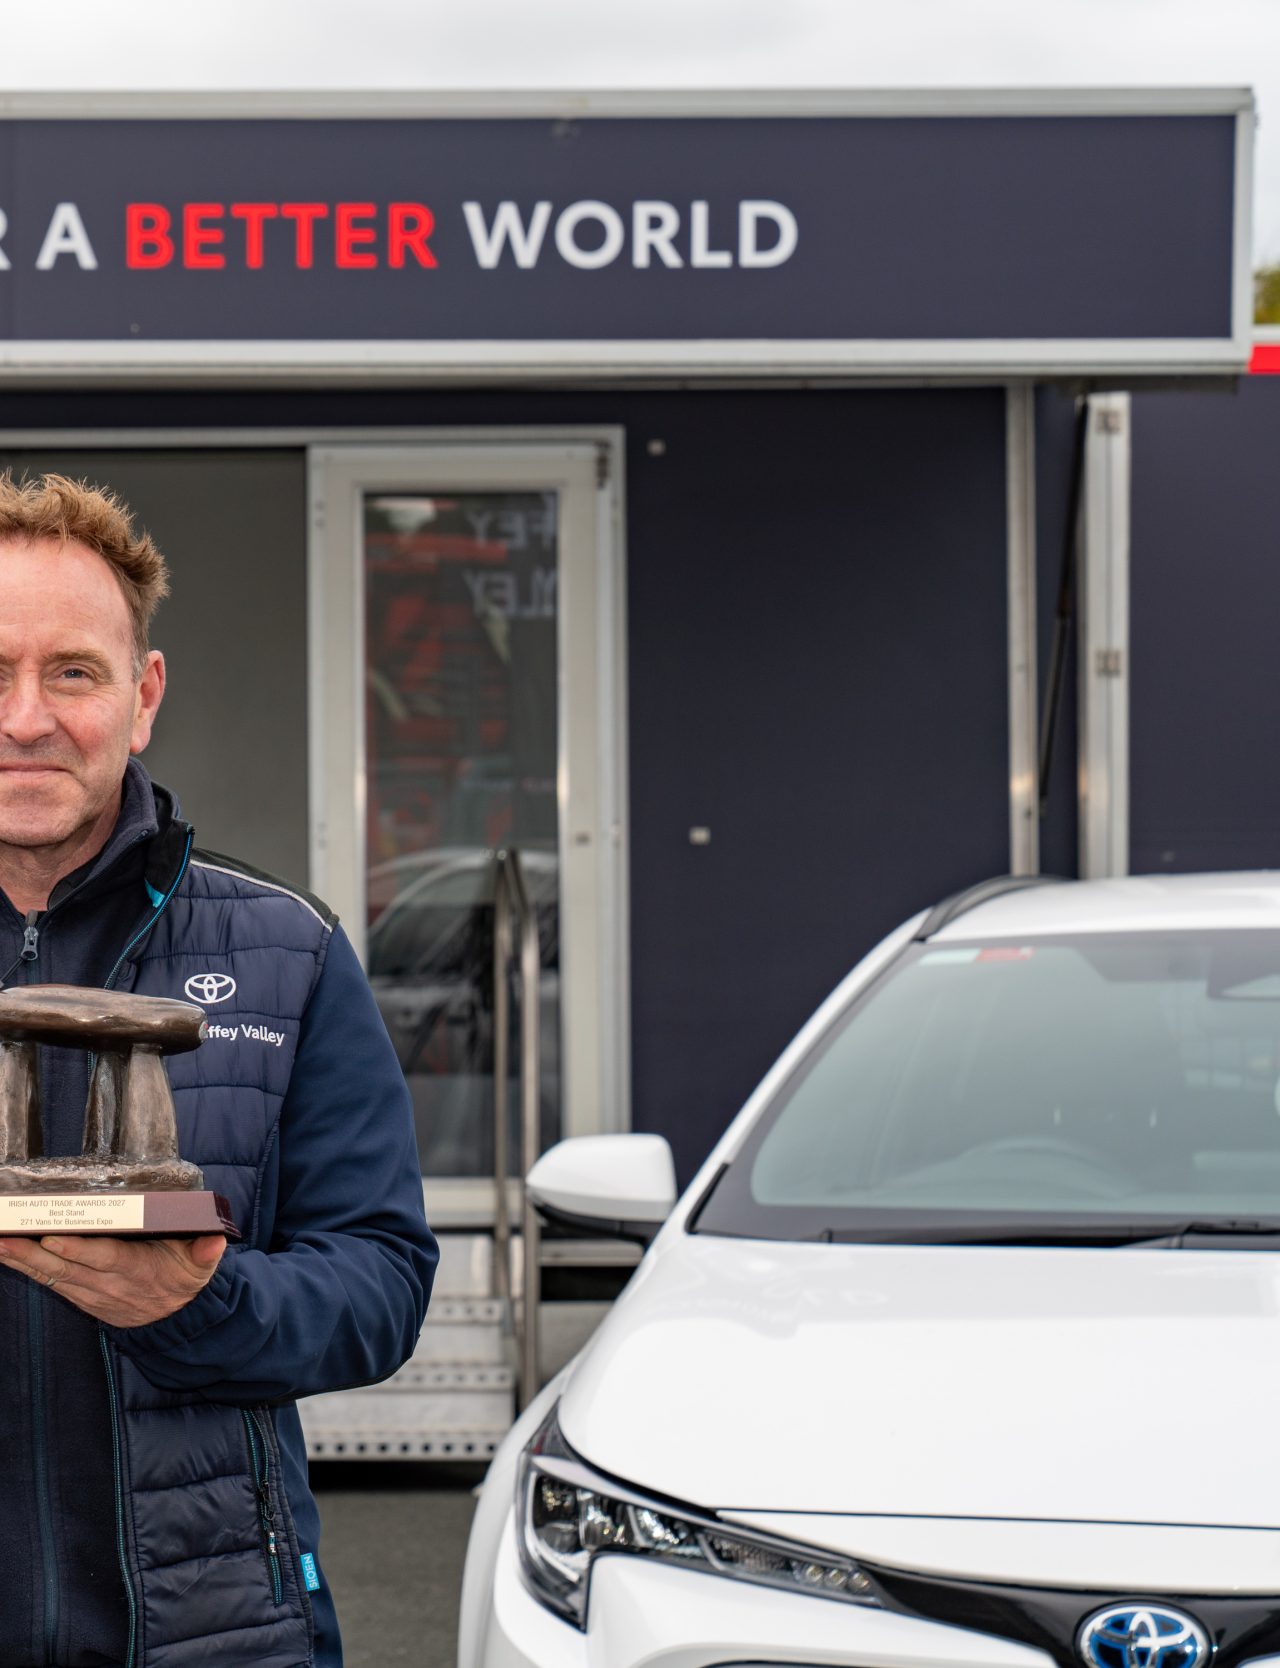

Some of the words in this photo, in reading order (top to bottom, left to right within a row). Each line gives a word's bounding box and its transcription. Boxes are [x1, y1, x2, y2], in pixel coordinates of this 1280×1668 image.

[35, 202, 98, 271] A
[125, 202, 438, 271] BETTER
[462, 200, 799, 270] WORLD
[207, 1025, 238, 1041] ffey
[240, 1023, 285, 1047] Valley
[50, 1199, 74, 1207] TRADE
[75, 1199, 107, 1207] AWARDS
[108, 1199, 126, 1207] 2027
[49, 1209, 64, 1217] Best
[65, 1209, 85, 1217] Stand
[20, 1218, 33, 1226] 271
[35, 1218, 51, 1226] Vans
[96, 1218, 113, 1226] Expo
[303, 1555, 318, 1588] SIOEN
